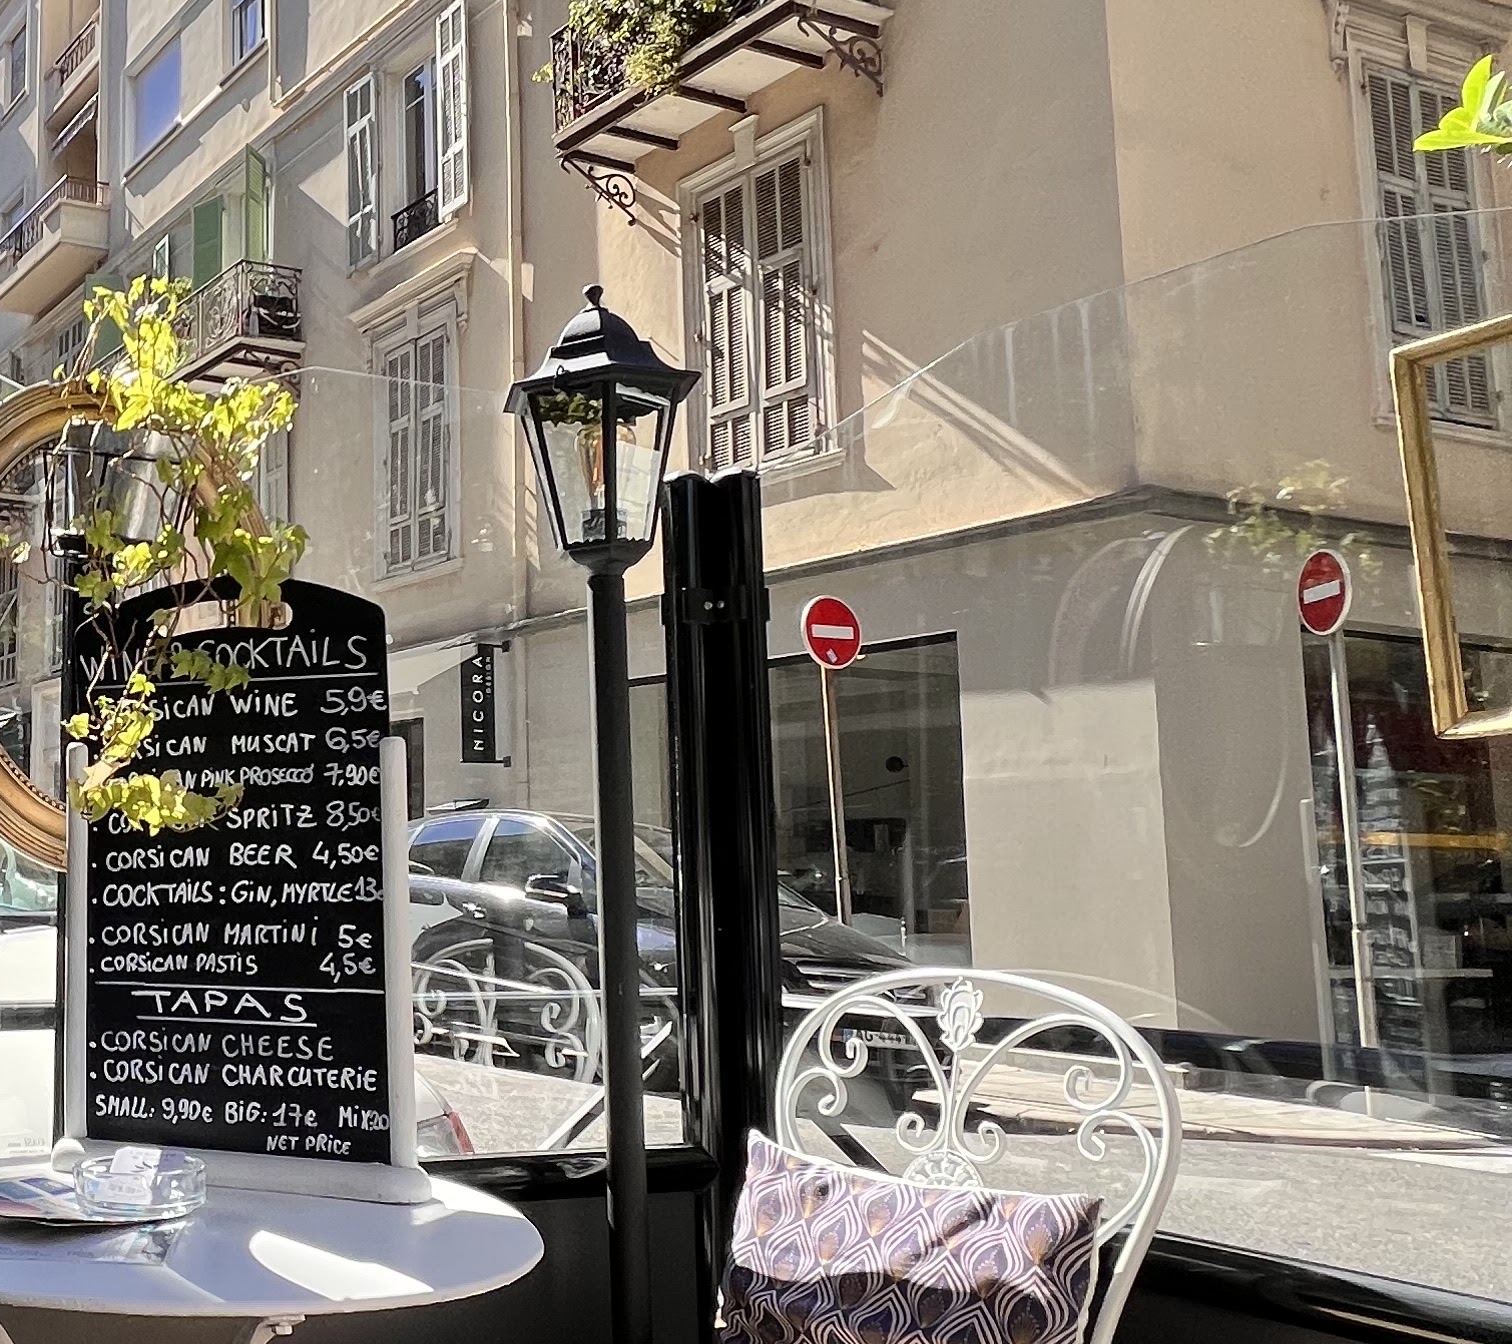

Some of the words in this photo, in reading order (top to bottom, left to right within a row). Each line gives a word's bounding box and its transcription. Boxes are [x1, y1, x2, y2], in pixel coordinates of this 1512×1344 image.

[320, 686, 388, 716] 5,9€
[471, 656, 485, 751] NICORA
[231, 733, 317, 755] MUSCAT
[325, 727, 381, 753] 6,5€
[323, 762, 381, 787] 7,90€
[326, 800, 381, 832] 8,50€
[229, 842, 298, 869] BEER
[311, 841, 379, 870] 4,50€
[282, 881, 354, 904] MYRTLE
[338, 924, 373, 949] 5€
[319, 952, 377, 984] 4,5€
[131, 989, 308, 1024] TAPAS
[221, 1032, 334, 1061] CHEESE
[265, 1134, 300, 1153] NET
